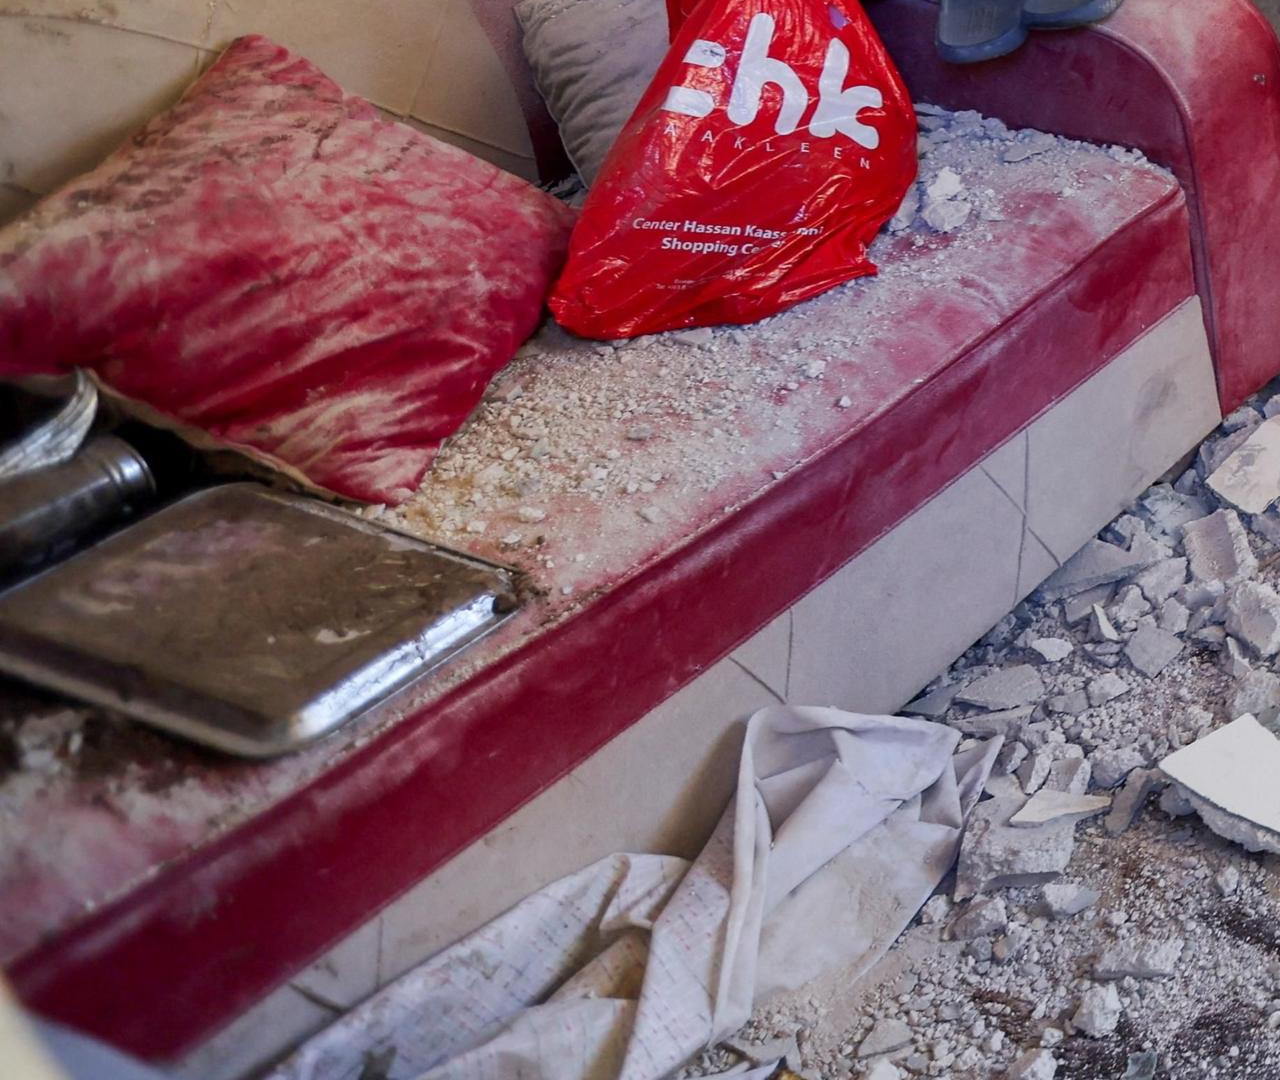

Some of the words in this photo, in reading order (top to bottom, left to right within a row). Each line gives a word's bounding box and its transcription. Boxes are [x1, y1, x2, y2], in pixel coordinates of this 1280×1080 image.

[664, 123, 871, 170] AAKLEEN
[632, 217, 680, 233] Center
[683, 220, 741, 236] Hassan
[661, 237, 738, 257] Shopping
[741, 240, 787, 255] Ceer
